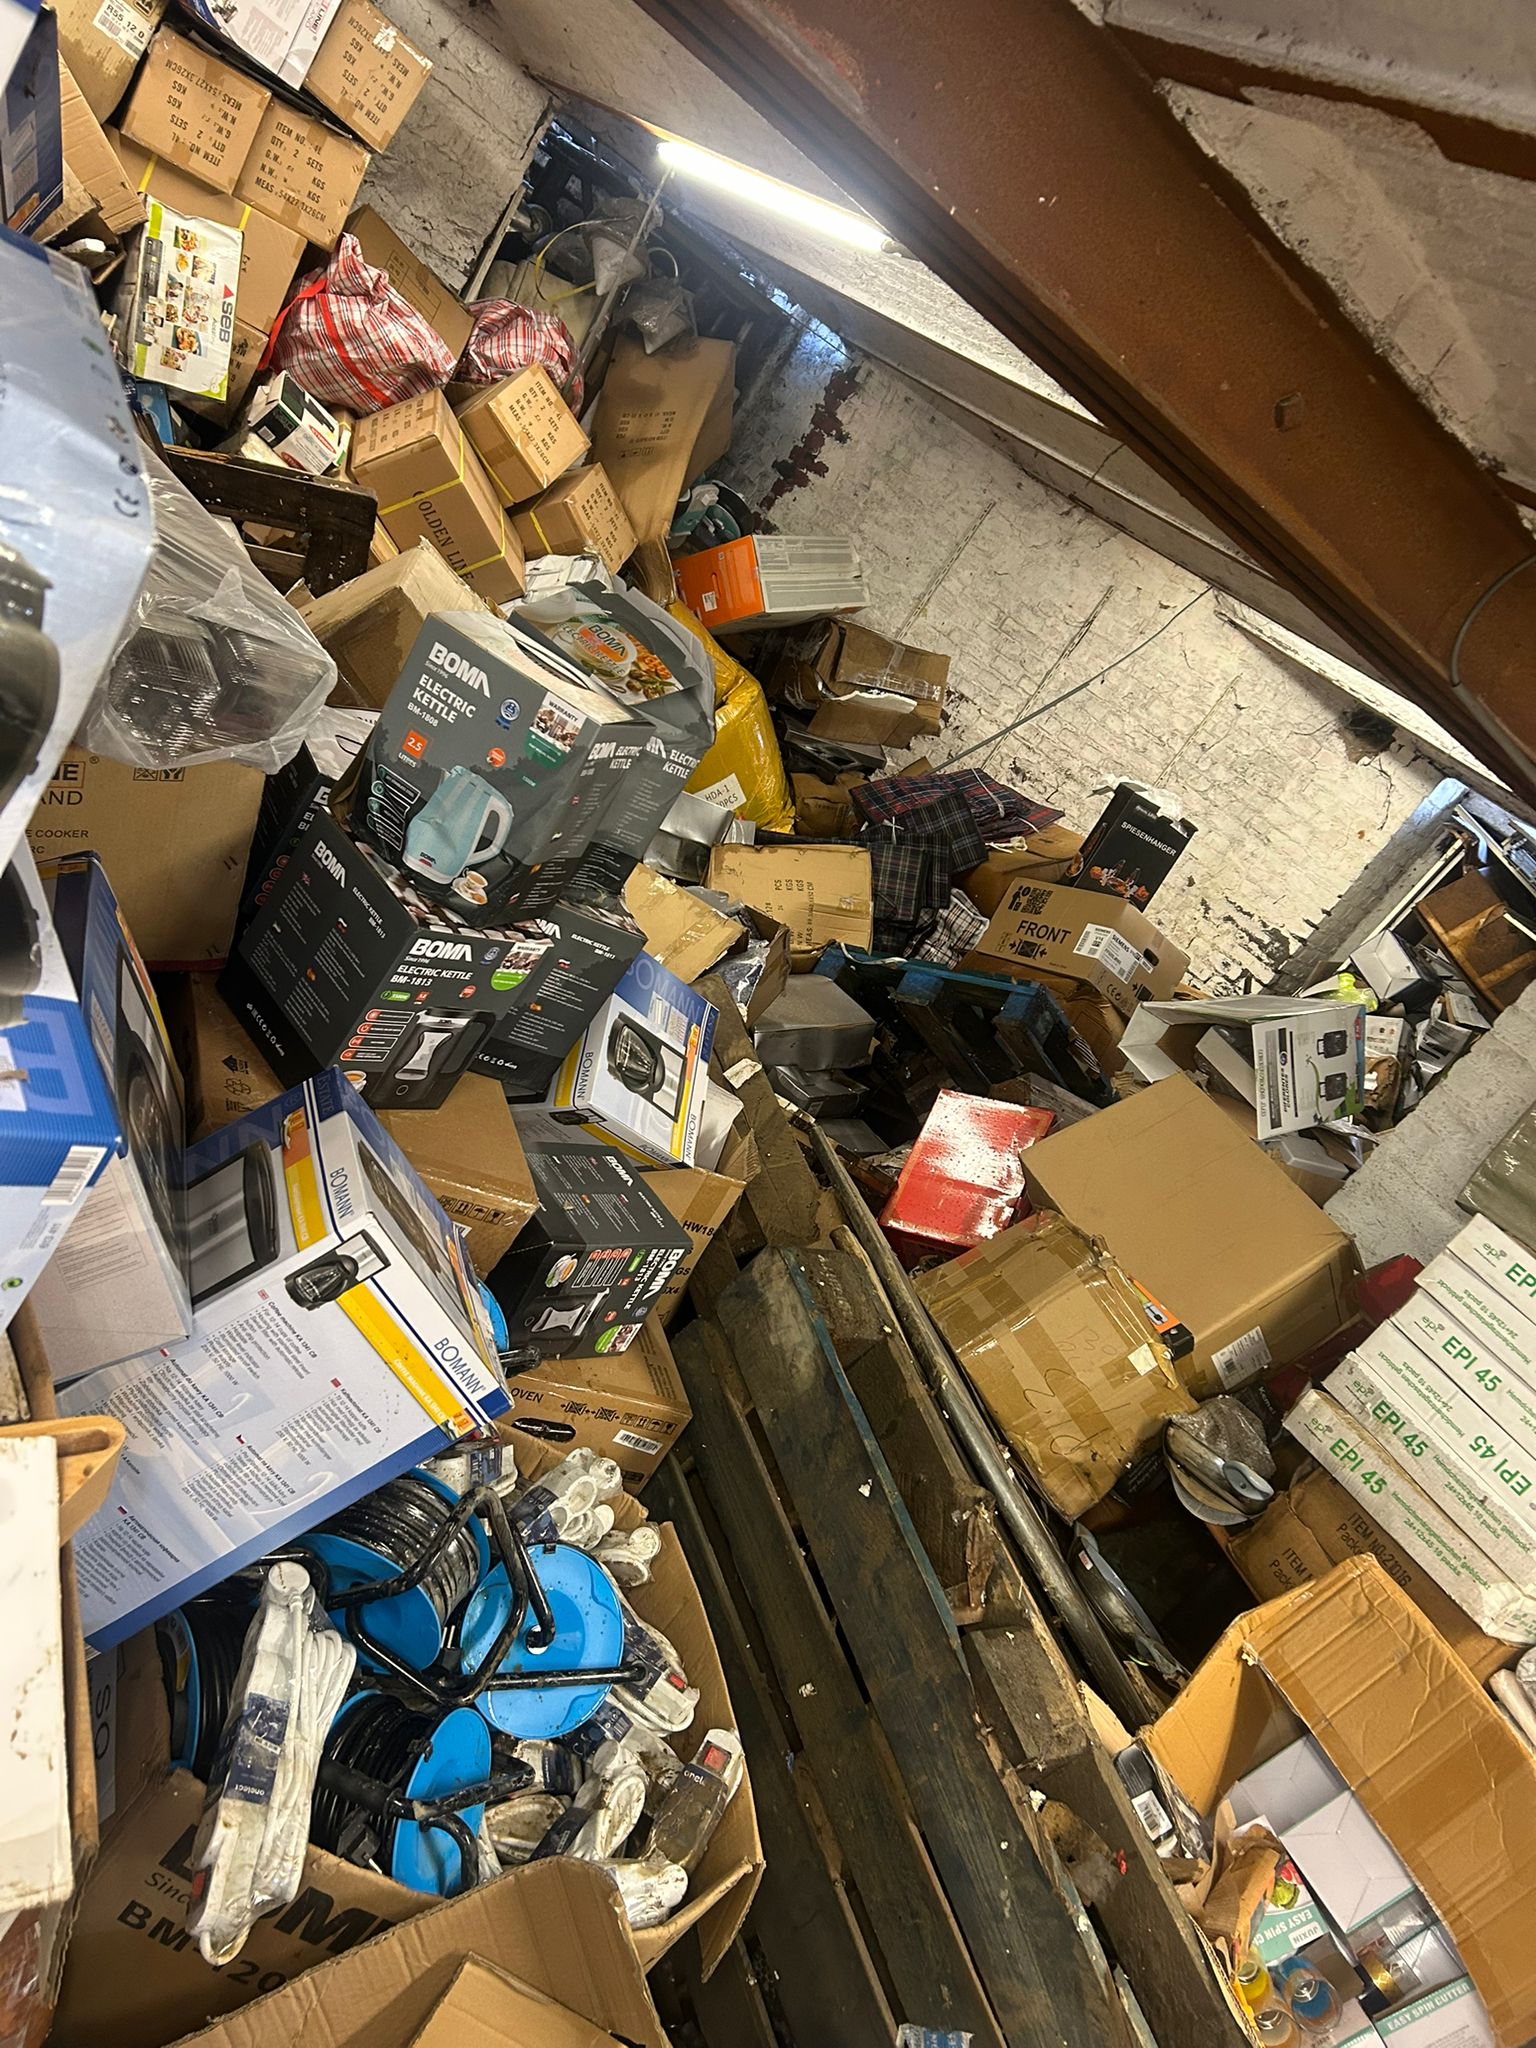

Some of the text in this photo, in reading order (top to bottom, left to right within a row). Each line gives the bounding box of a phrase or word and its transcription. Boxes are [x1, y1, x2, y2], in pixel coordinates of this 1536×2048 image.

[171, 80, 188, 95] KGS
[342, 69, 359, 87] SETS
[166, 95, 183, 110] KGS
[222, 96, 243, 111] MEAS
[170, 113, 203, 139] 2 SETS
[275, 122, 293, 137] ITEM
[365, 109, 381, 125] ITEM
[202, 152, 221, 167] ITEM
[293, 149, 324, 172] 2 SETS
[255, 177, 275, 193] MEAS
[312, 177, 326, 190] KGS
[307, 190, 321, 204] KGS
[428, 641, 491, 699] BOMA
[412, 687, 458, 724] KETTLE
[419, 673, 477, 719] ELECTRIC
[407, 702, 439, 727] BM-1808
[407, 737, 423, 752] 2.5
[609, 758, 633, 769] KETTLE
[662, 761, 691, 779] KETTLE
[35, 829, 89, 839] COOKER
[1121, 821, 1177, 857] SPIESENHANGER
[314, 840, 347, 888] BOMA
[1016, 920, 1071, 944] FRONT
[408, 938, 473, 962] BOMA
[390, 974, 433, 987] BM-1813
[396, 965, 474, 981] ELECTRIC KETTLE
[578, 1051, 594, 1100] BOMANN
[684, 1114, 696, 1164] BOMANN
[604, 1155, 634, 1187] BOMA
[330, 1167, 353, 1219] BOMANN
[642, 1249, 686, 1301] BOMA
[624, 1278, 647, 1310] KETTLE
[267, 1300, 283, 1317] Coffee
[280, 1315, 297, 1335] machine
[169, 1356, 189, 1379] Automat
[434, 1337, 484, 1394] BOMANN
[1440, 1334, 1479, 1371] EPI
[1470, 1363, 1503, 1394] 45
[510, 1386, 545, 1404] OVEN
[1369, 1398, 1408, 1436] EPI
[1399, 1429, 1430, 1459] 45
[1466, 1432, 1500, 1465] 45
[1327, 1436, 1365, 1473] EPI
[1357, 1465, 1388, 1496] 45
[1490, 1456, 1534, 1498] EPI
[1345, 1510, 1376, 1540] ITEM
[1281, 1546, 1308, 1576] ITEM
[1263, 1909, 1313, 1941] EASY SPIN
[1387, 1984, 1471, 2030] EASY SPIN CUTTER
